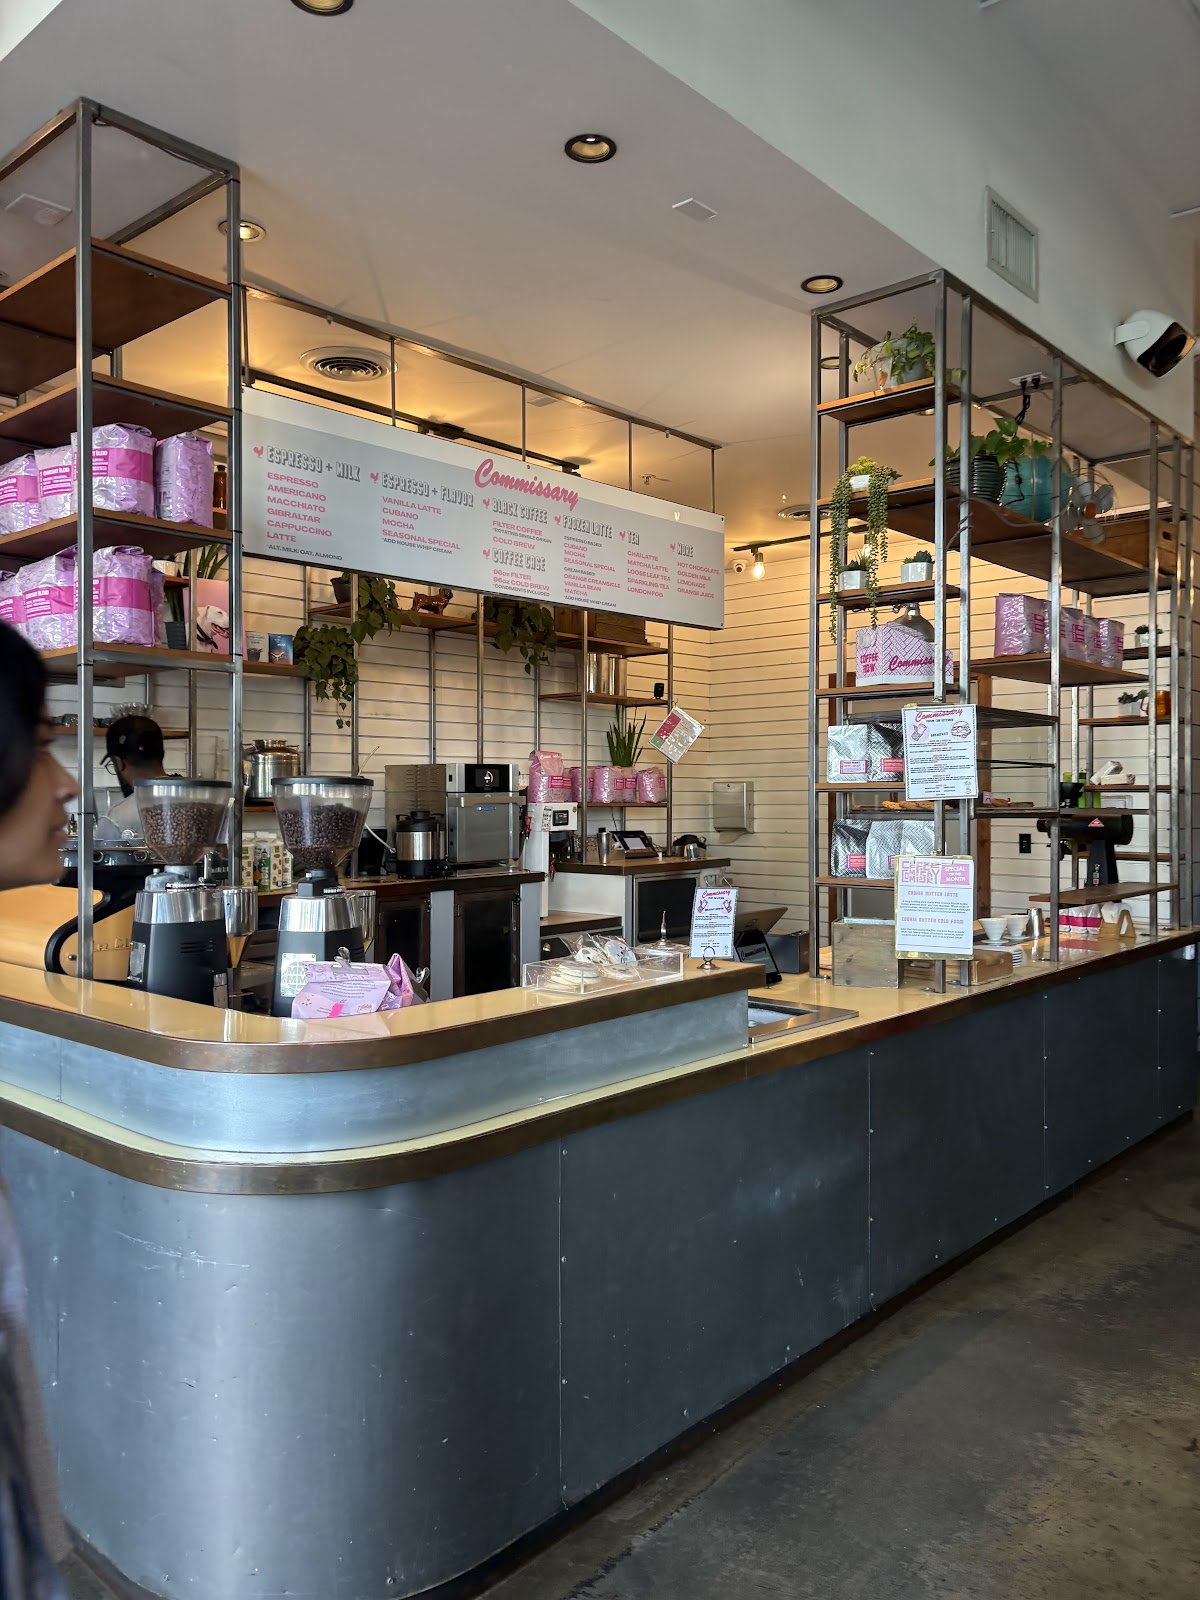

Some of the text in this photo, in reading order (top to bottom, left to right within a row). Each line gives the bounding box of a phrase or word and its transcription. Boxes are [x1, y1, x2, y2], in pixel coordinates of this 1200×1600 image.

[267, 446, 322, 473] ESPRESSO
[336, 461, 360, 482] MILK
[267, 472, 319, 488] ESPRESSO
[474, 458, 579, 511] Commissary
[267, 484, 326, 501] AMERICANO
[382, 472, 429, 497] ESPRESSO
[441, 485, 473, 507] FLAVOR
[267, 496, 325, 512] MACCHIATO
[382, 496, 442, 514] VANILLA LATTE
[267, 508, 320, 523] GIBRALTAR
[382, 507, 419, 520] CUBANO
[492, 498, 548, 524] BLACK COFFEE
[267, 519, 332, 537] CAPPUCCINO
[382, 518, 415, 530] MOCHA
[493, 521, 543, 536] FILTER COFFEE
[563, 515, 613, 539] FROZEN LATTE
[266, 531, 296, 542] LATTE
[382, 529, 460, 549] SEASONAL SPECIAL
[493, 536, 536, 549] COLD BREW
[627, 530, 640, 546] TEA
[397, 539, 416, 548] HOUSE
[564, 543, 587, 552] CUBANO
[677, 543, 693, 557] MORE
[315, 552, 343, 561] ALMOND
[492, 548, 545, 572] COFFEE CASE
[564, 550, 585, 558] MOCHA
[627, 550, 658, 561] CHAI LATTE
[564, 558, 615, 572] SEASONAL SPECIAL
[627, 560, 668, 572] MATCHA LATTE
[689, 564, 719, 574] CHOCOLATE
[511, 572, 531, 580] FILTER
[564, 574, 621, 588] ORANGE CREAMSICLE
[677, 570, 699, 579] GOLDEN
[564, 581, 586, 589] VANILLA
[628, 578, 659, 588] SPARKLING
[677, 579, 705, 589] LEMONADE
[564, 588, 588, 596] MATCHA
[628, 587, 651, 596] LONDON
[677, 588, 699, 596] ORANGE
[860, 652, 878, 664] COFFEE
[915, 709, 963, 722] Commissary
